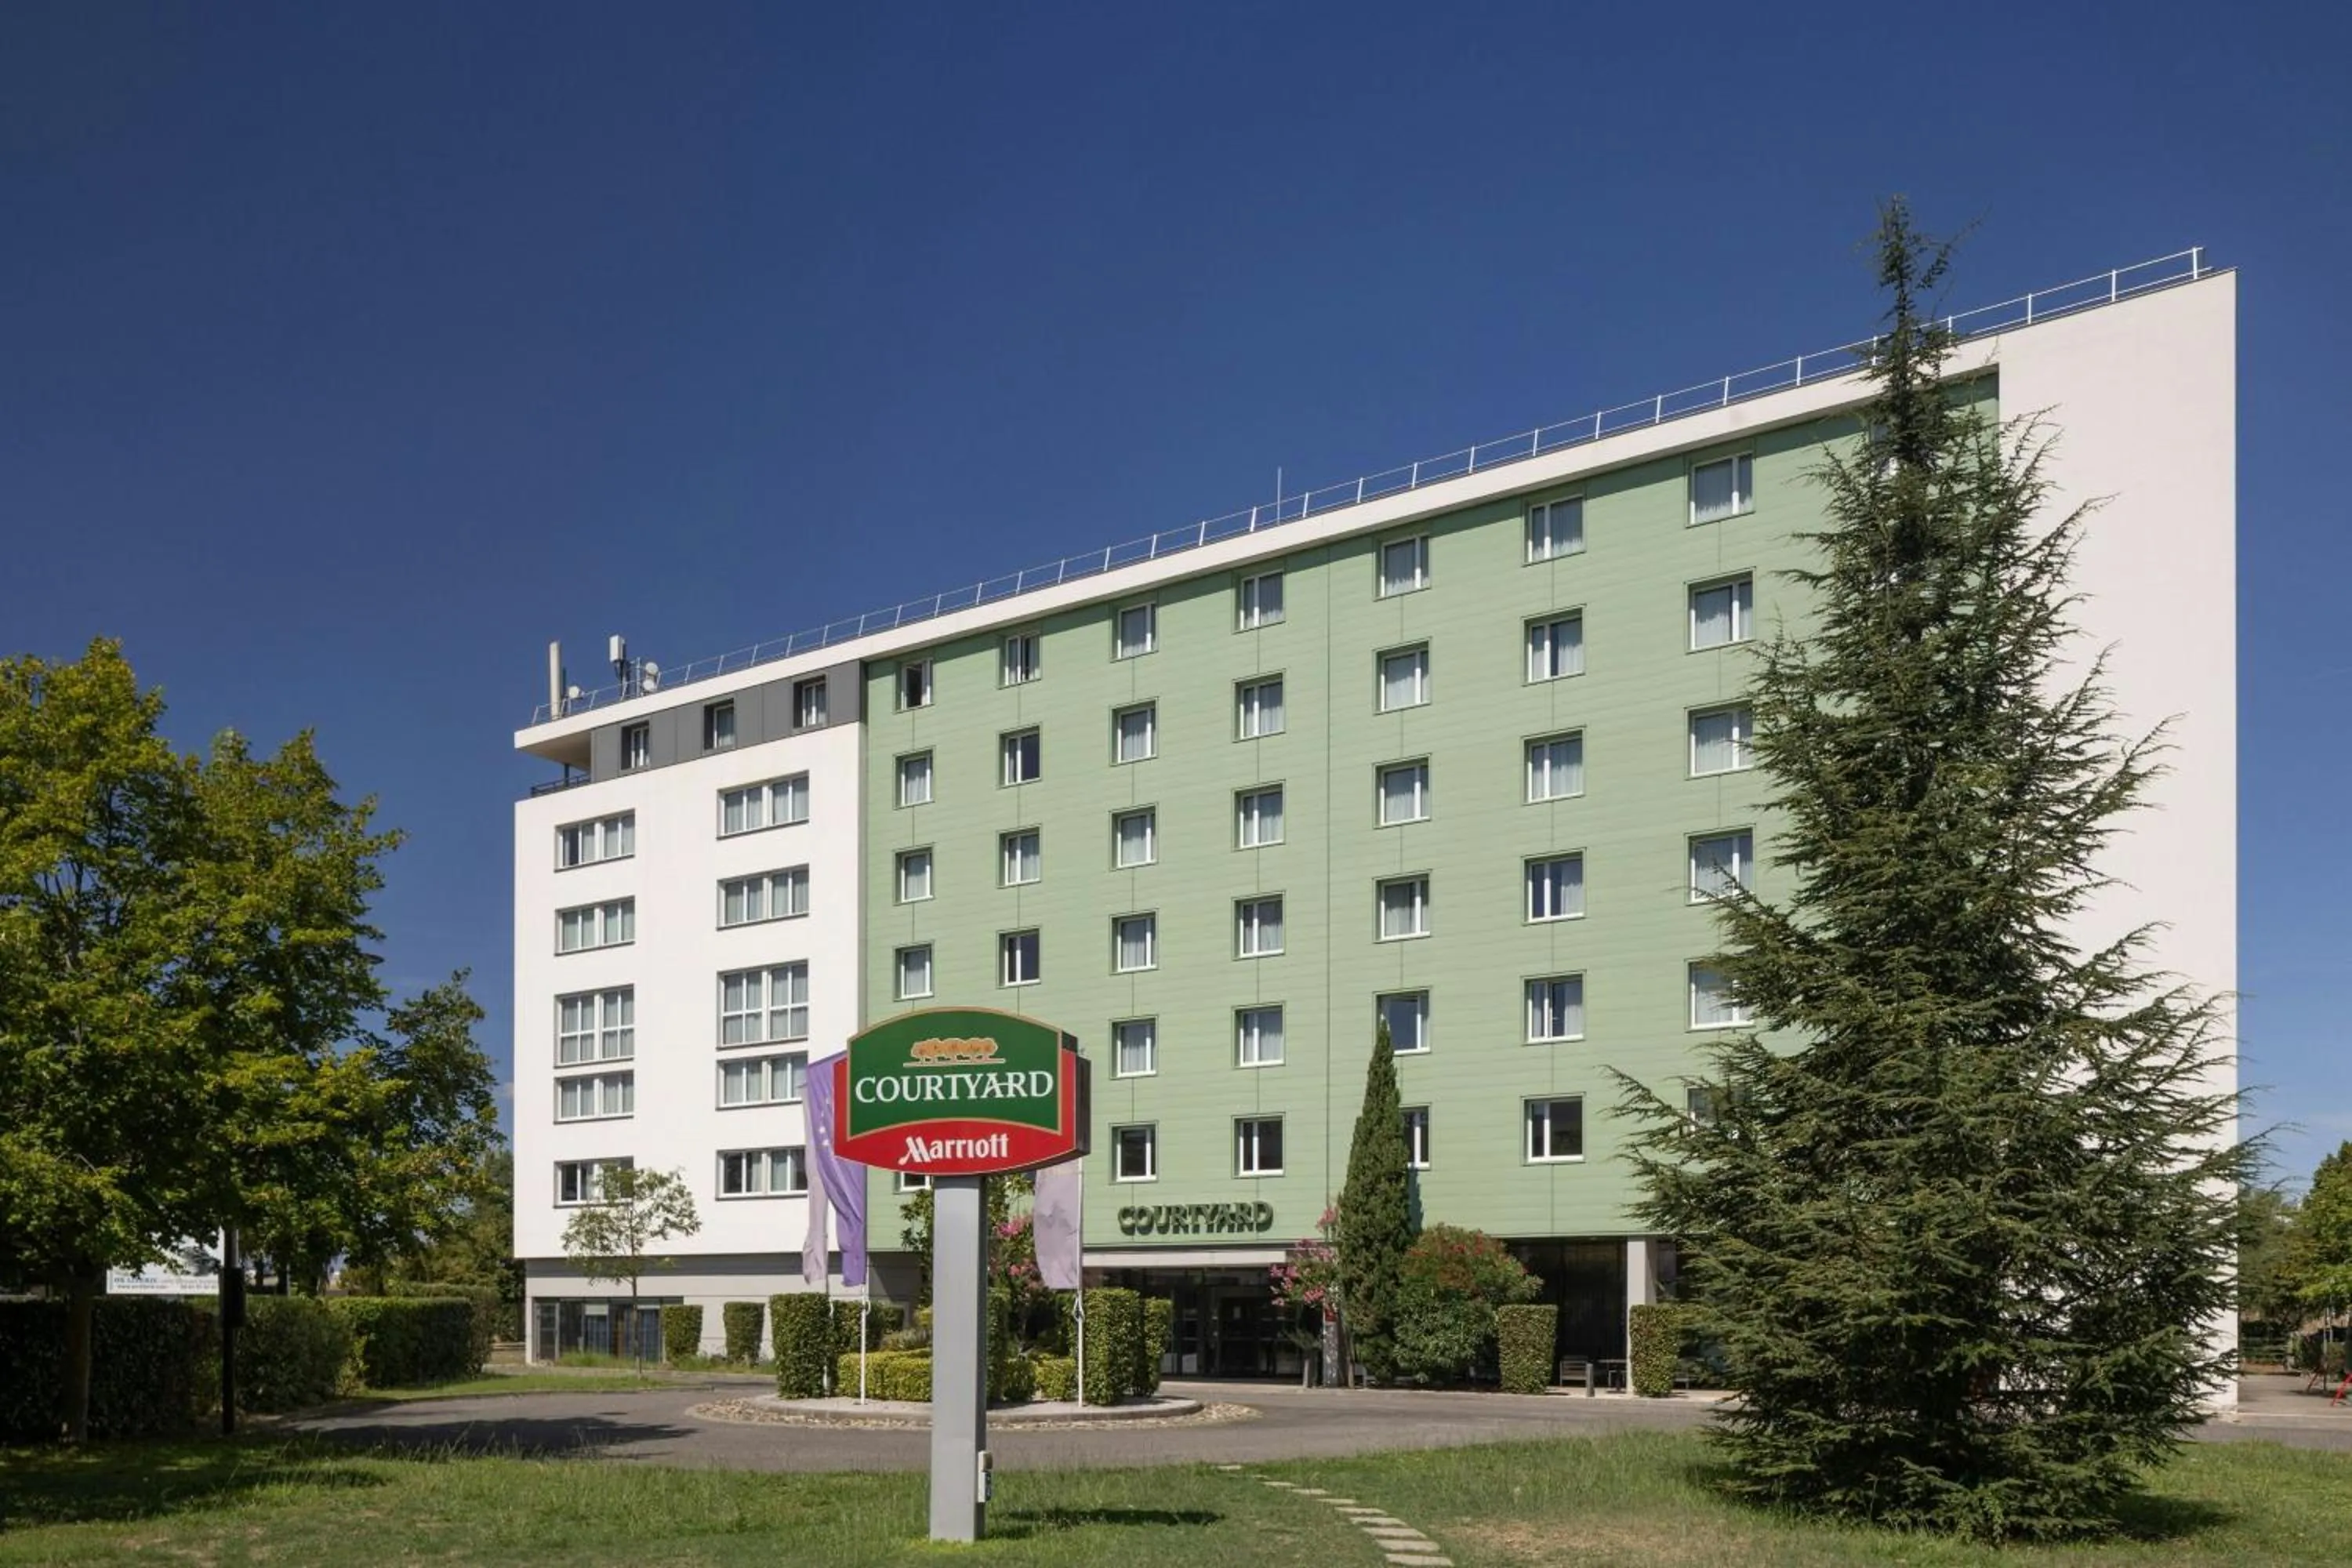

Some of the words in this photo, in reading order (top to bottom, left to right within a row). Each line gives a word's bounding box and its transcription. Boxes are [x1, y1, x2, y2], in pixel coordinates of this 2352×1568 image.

[855, 1071, 1054, 1103] COURTYARD
[898, 1134, 1009, 1165] Marriott
[1117, 1201, 1274, 1236] COURTYARD
